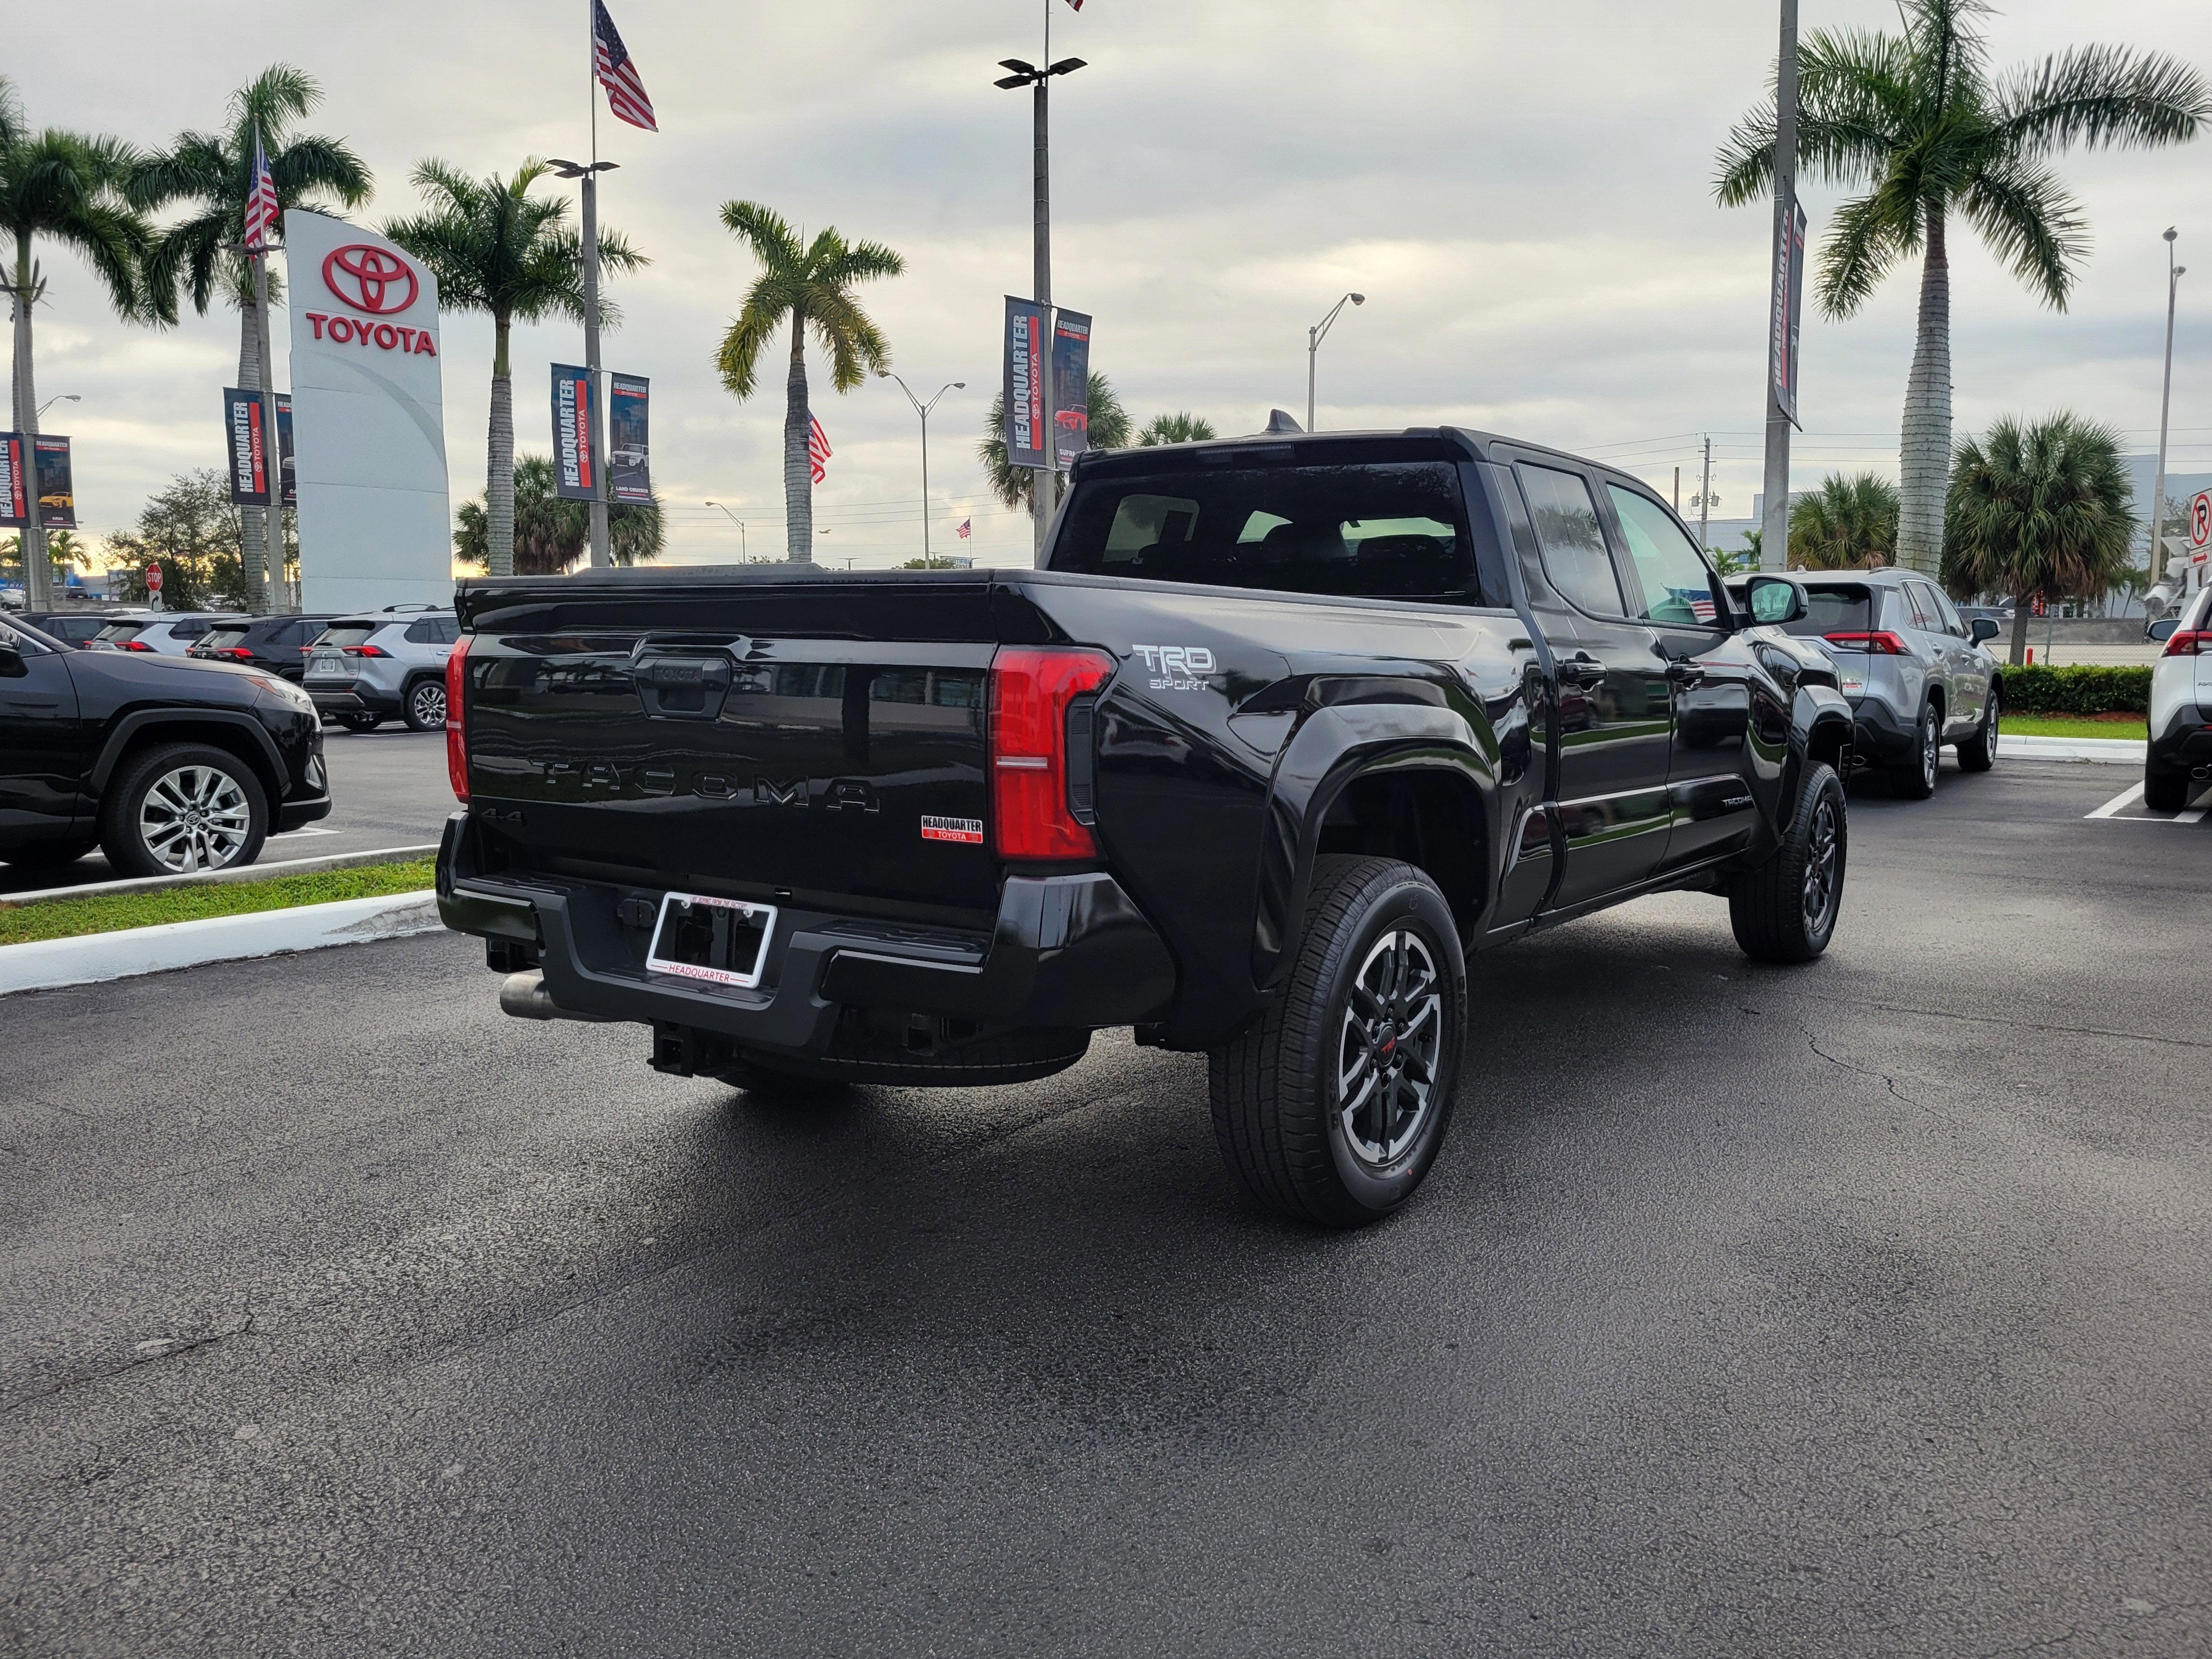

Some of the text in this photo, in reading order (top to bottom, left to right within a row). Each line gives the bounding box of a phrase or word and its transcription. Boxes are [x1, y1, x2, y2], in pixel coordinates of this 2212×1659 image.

[1774, 207, 1788, 387] HEADQUARTER
[306, 313, 437, 356] TOYOTA
[1057, 320, 1088, 335] HEADQUARTER
[614, 382, 646, 393] HEADQUARTER
[1013, 315, 1030, 449] HEADQUARTER
[560, 379, 580, 487] HEADQUARTER
[233, 402, 254, 493] HEADQUARTER
[1059, 448, 1075, 457] SUPRA
[147, 572, 161, 583] STOP
[1132, 645, 1215, 677] TRD
[1149, 678, 1209, 691] SPORT
[529, 758, 881, 815] TACOMA
[922, 816, 981, 832] HEADQUARTER
[938, 831, 967, 840] TOYOTA
[669, 964, 730, 982] HEADQUARTER
